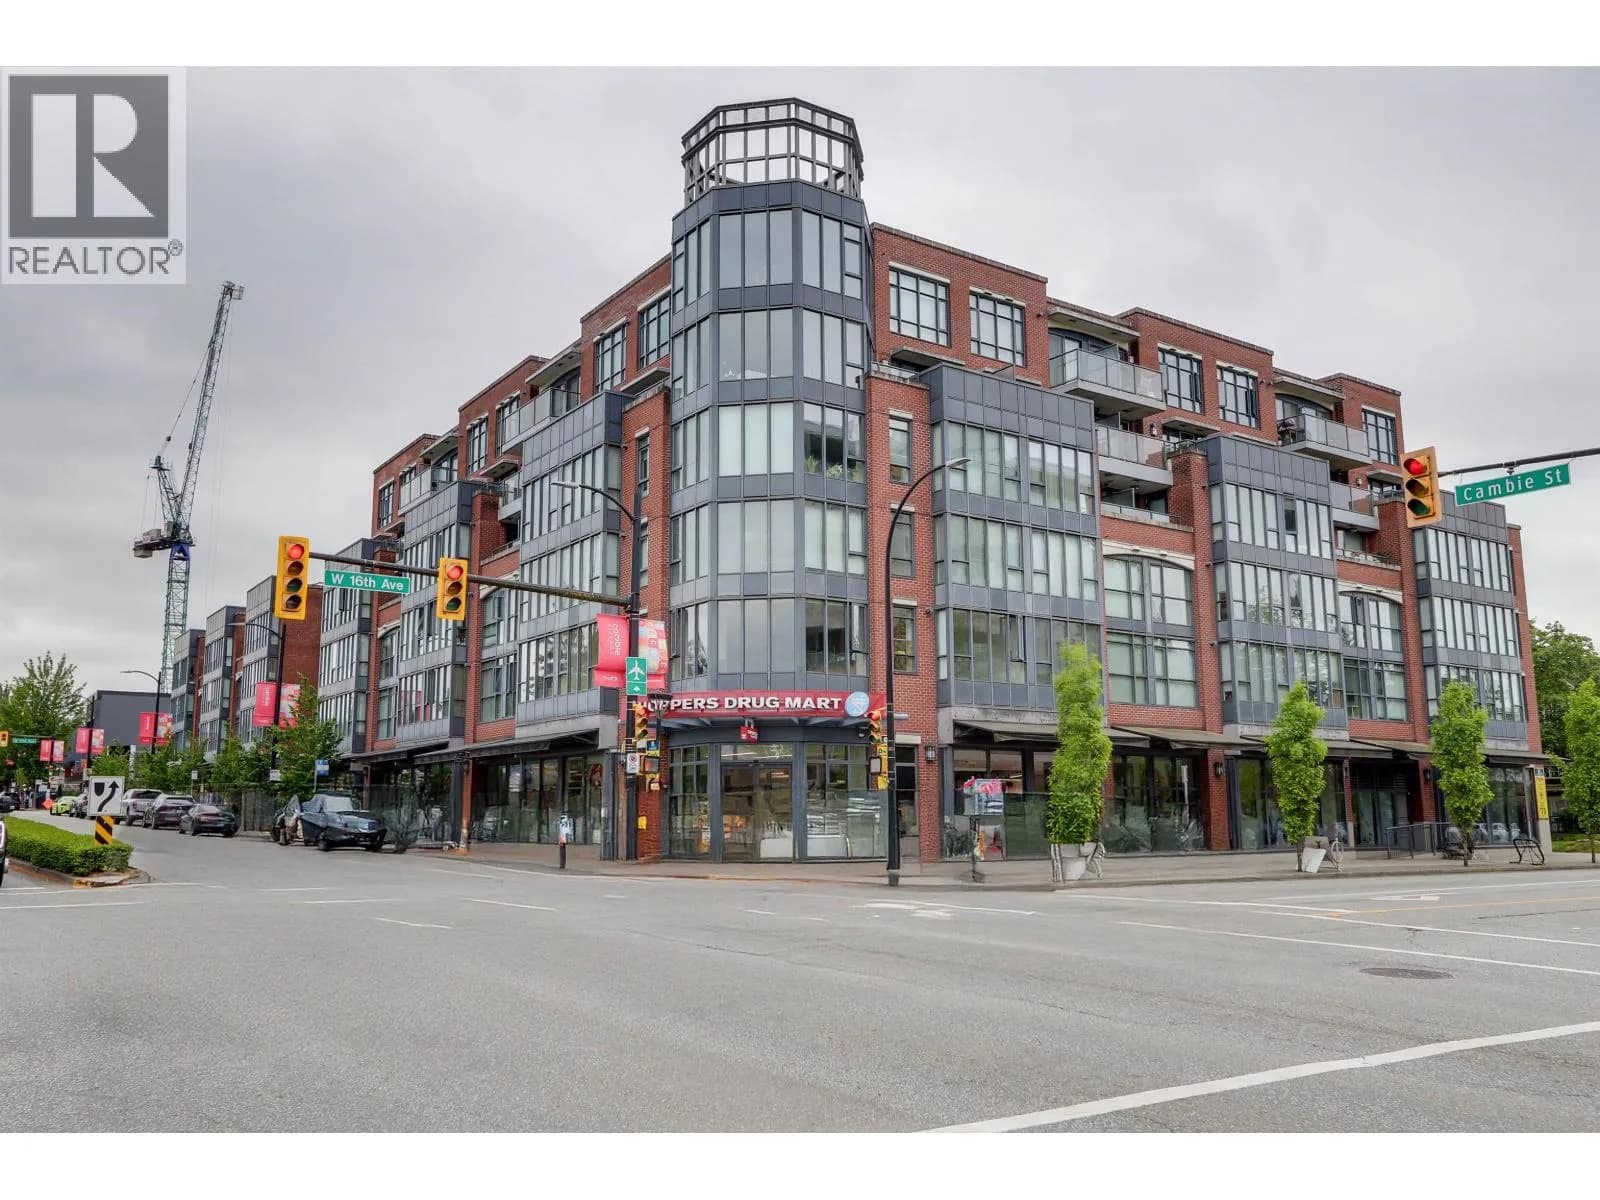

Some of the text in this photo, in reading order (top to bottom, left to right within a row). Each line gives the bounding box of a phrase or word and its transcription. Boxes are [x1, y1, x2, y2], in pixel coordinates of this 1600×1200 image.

[1463, 468, 1562, 501] Cambie St
[331, 572, 404, 591] W 16th Ave
[724, 696, 780, 709] DRUG
[785, 697, 842, 709] MART
